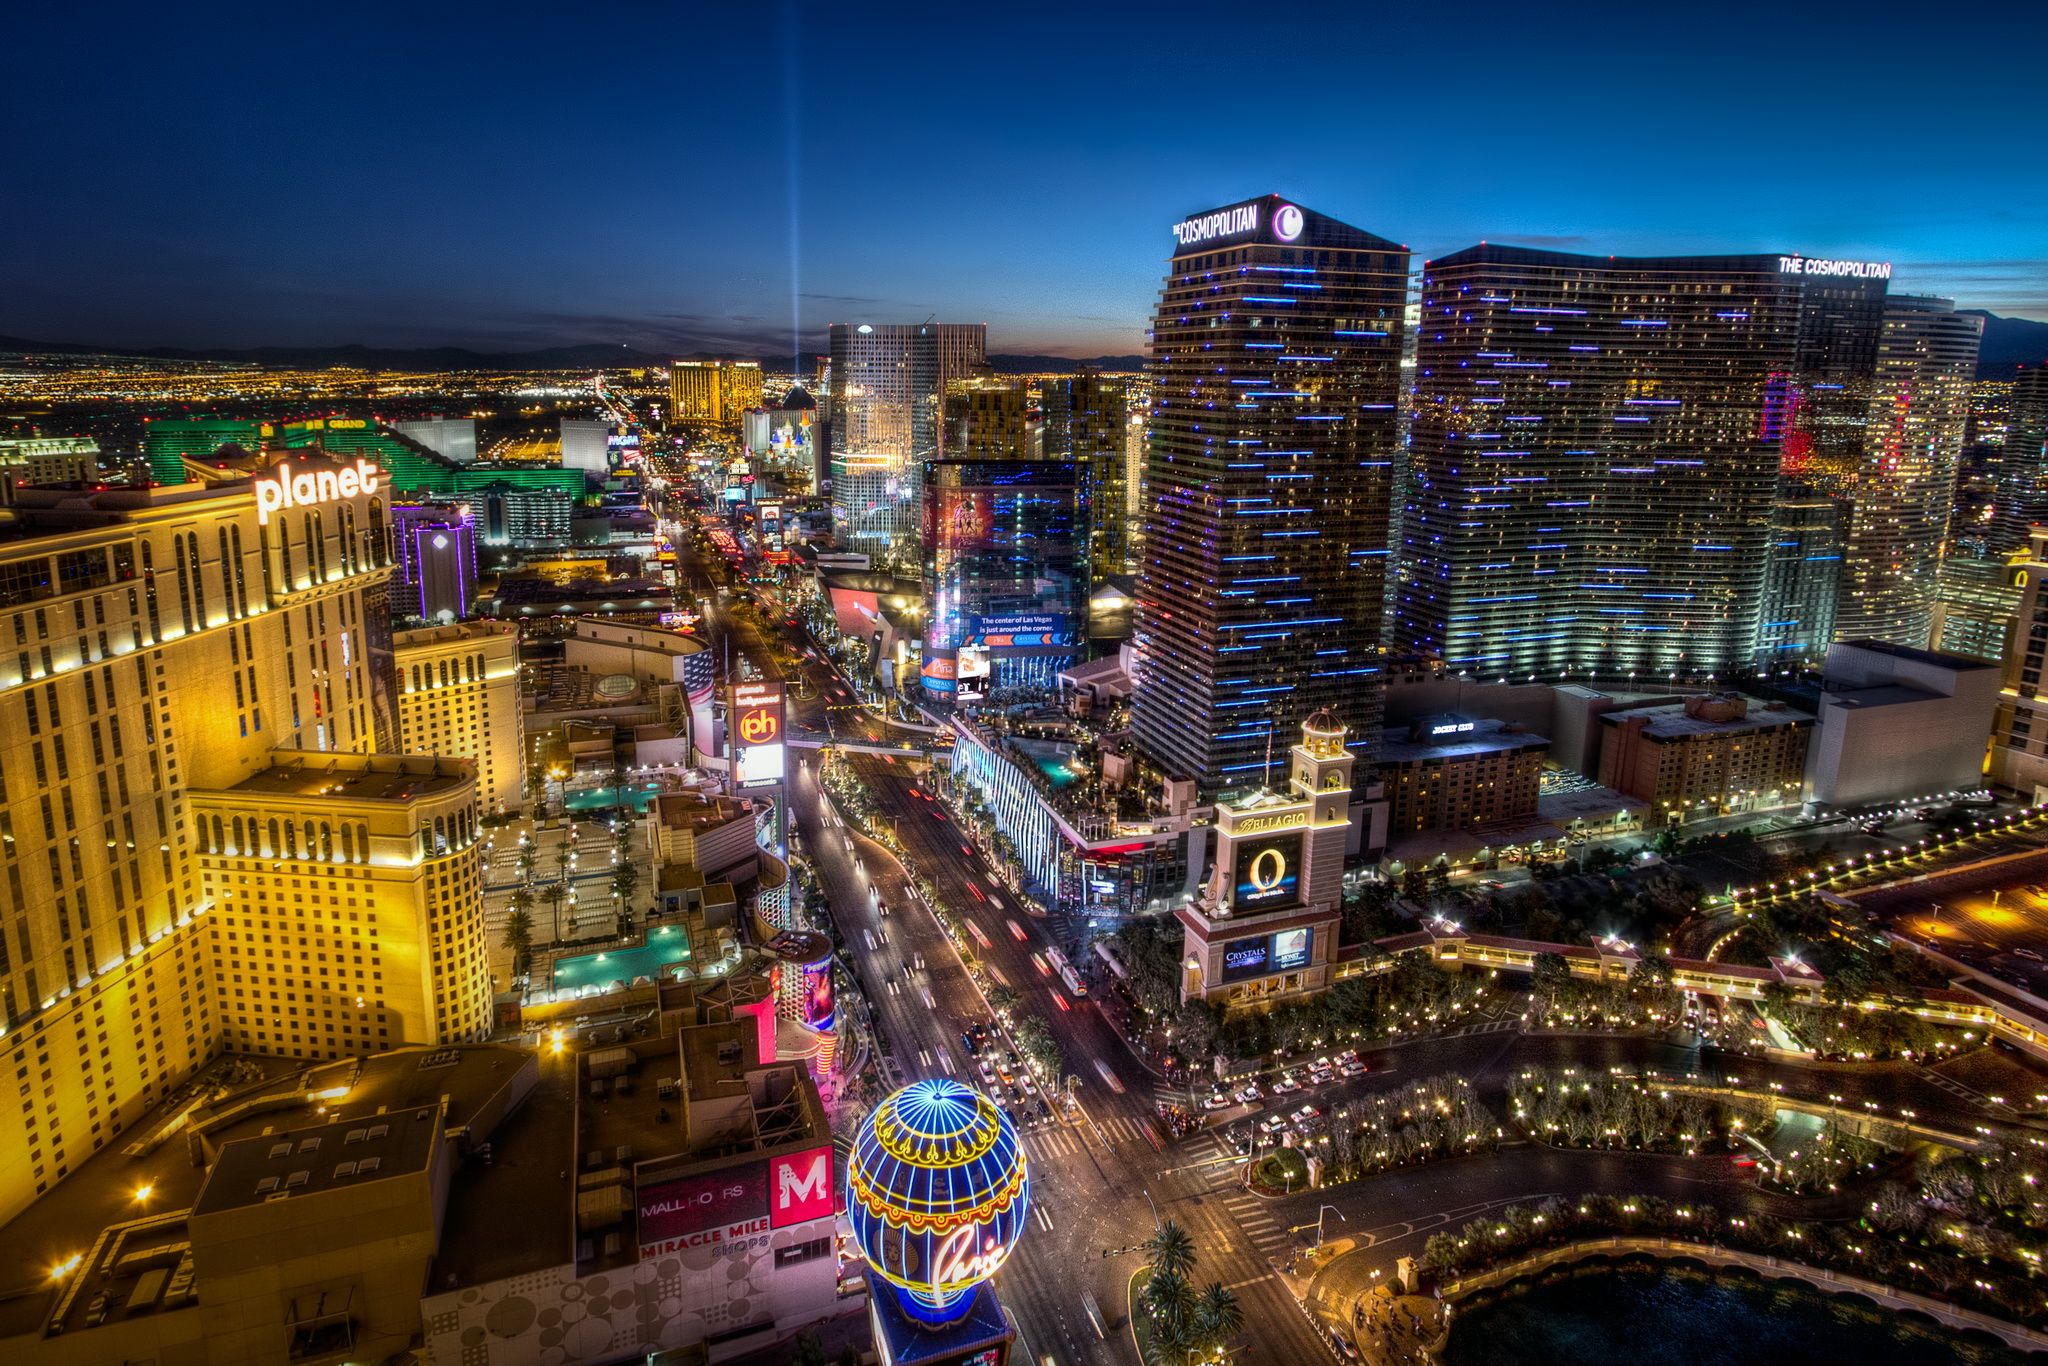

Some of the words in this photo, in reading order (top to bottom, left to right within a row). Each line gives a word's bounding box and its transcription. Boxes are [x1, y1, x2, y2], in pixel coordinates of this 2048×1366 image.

[1173, 224, 1181, 235] THE
[1180, 205, 1257, 244] COSMOPOLITAN
[1779, 257, 1804, 274] THE
[1805, 259, 1891, 279] COSMOPOLITAN
[328, 420, 367, 429] GRAND
[607, 435, 640, 446] MGM
[255, 459, 378, 526] planet
[986, 626, 1000, 634] just
[1015, 616, 1022, 624] of
[1034, 616, 1053, 624] Vegas
[932, 660, 952, 673] Aria
[736, 694, 780, 706] hollywood
[744, 710, 777, 739] ph
[743, 778, 777, 788] Panasonic
[1240, 812, 1305, 833] BELLAGIO
[1249, 849, 1286, 890] O
[1226, 947, 1267, 961] CRYSTALS
[779, 1155, 827, 1209] M
[641, 1201, 685, 1218] MALL
[641, 1230, 721, 1259] MIRACLE
[729, 1218, 768, 1237] MILE
[711, 1234, 770, 1257] SHOPS
[932, 1223, 1005, 1308] Paris
